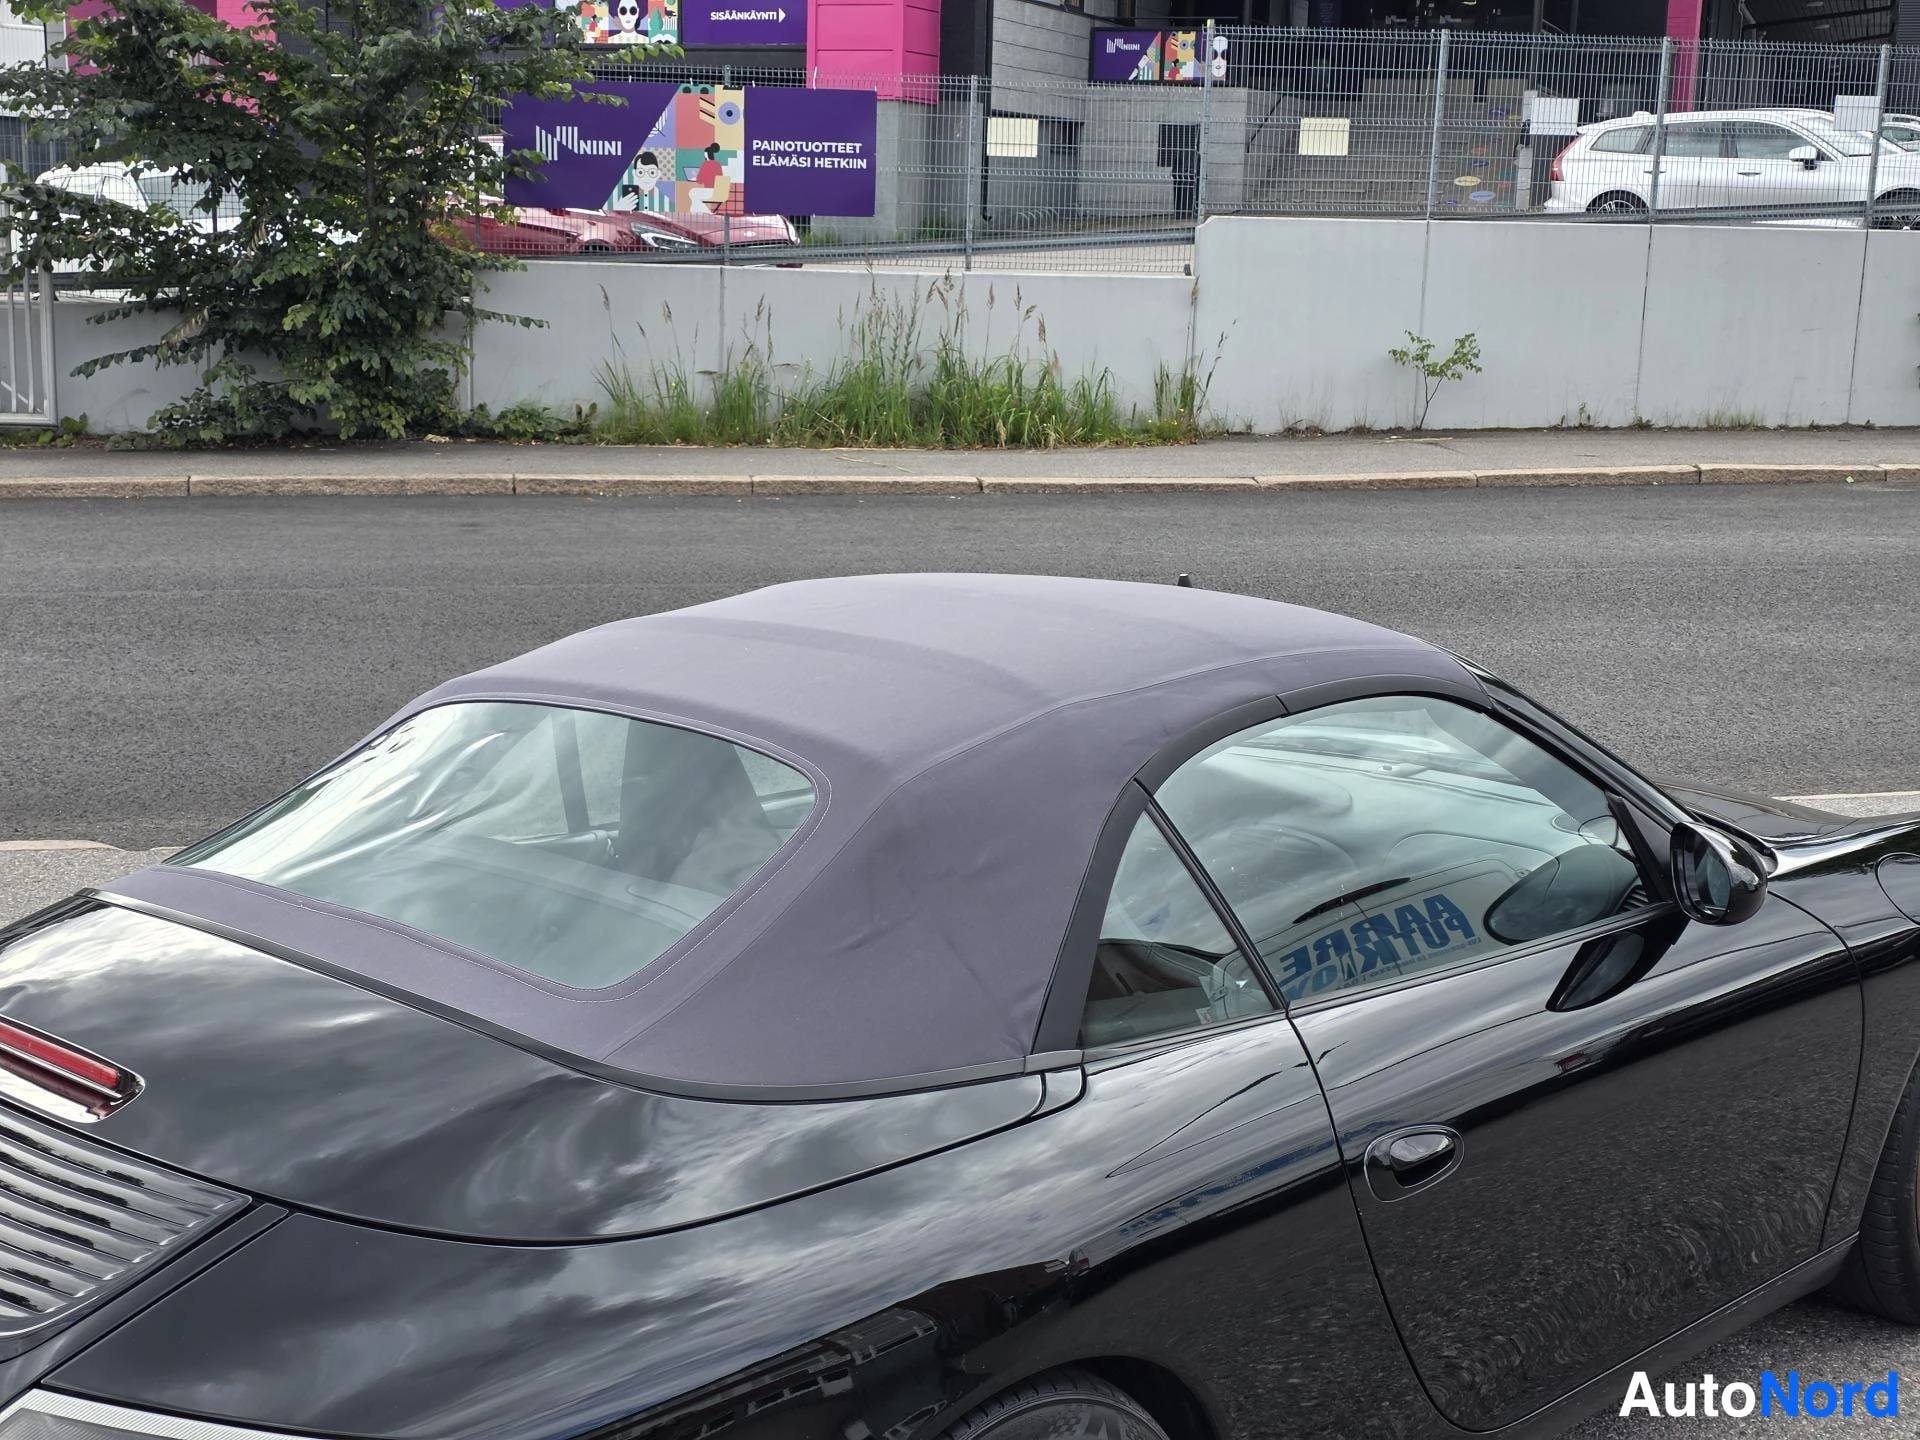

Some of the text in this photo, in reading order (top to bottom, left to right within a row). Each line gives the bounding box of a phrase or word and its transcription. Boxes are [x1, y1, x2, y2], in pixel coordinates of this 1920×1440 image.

[710, 10, 777, 20] SISÄÄNKÄYNTI
[579, 139, 622, 156] NIINI
[752, 139, 863, 154] PAINOTUOTTEET
[752, 153, 867, 169] ELÄMÄSI HETKIIN
